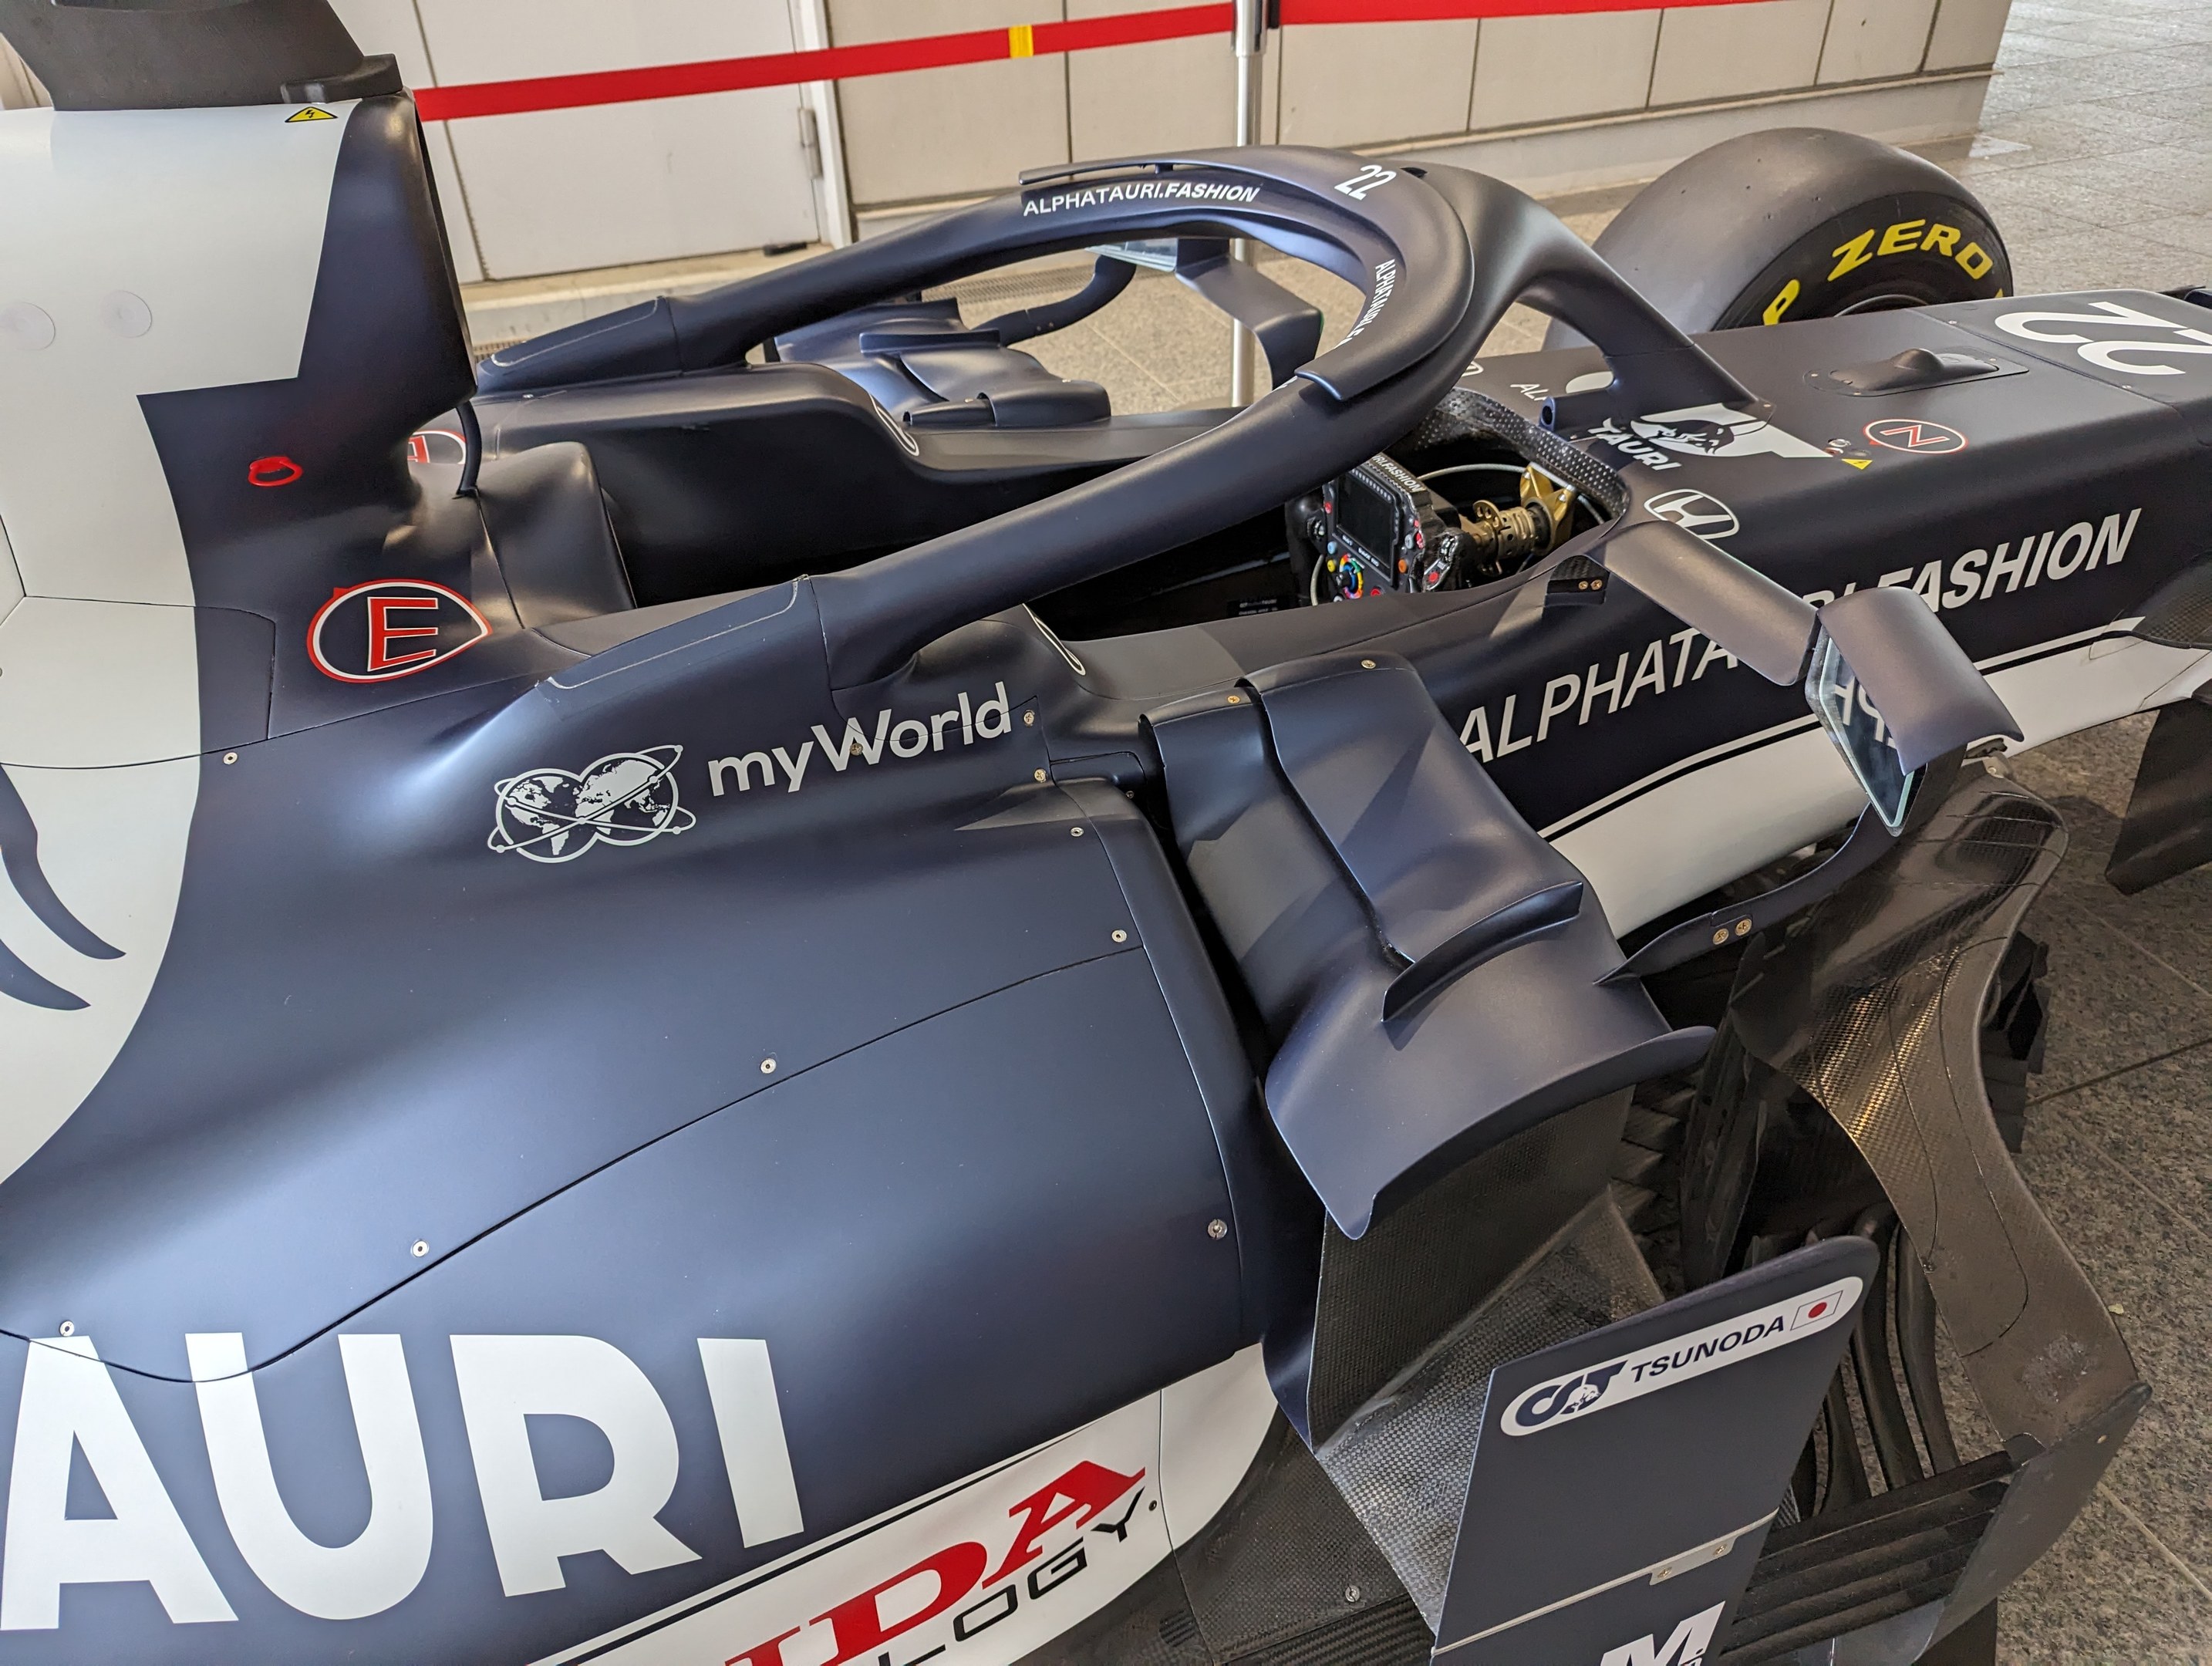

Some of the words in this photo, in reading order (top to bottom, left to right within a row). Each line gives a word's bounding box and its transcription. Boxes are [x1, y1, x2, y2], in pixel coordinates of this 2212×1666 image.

[1022, 180, 1261, 218] ALPHATAURI.FASHION
[1334, 164, 1398, 201] 22
[1826, 219, 1994, 282] ZERO
[1995, 301, 2212, 376] 22
[1587, 417, 1682, 471] TAURI
[367, 597, 439, 673] E
[707, 680, 1012, 797] myWorld
[1630, 1315, 1785, 1384] TSUNODA
[0, 1332, 804, 1631] AURI
[725, 1460, 1146, 1666] DA
